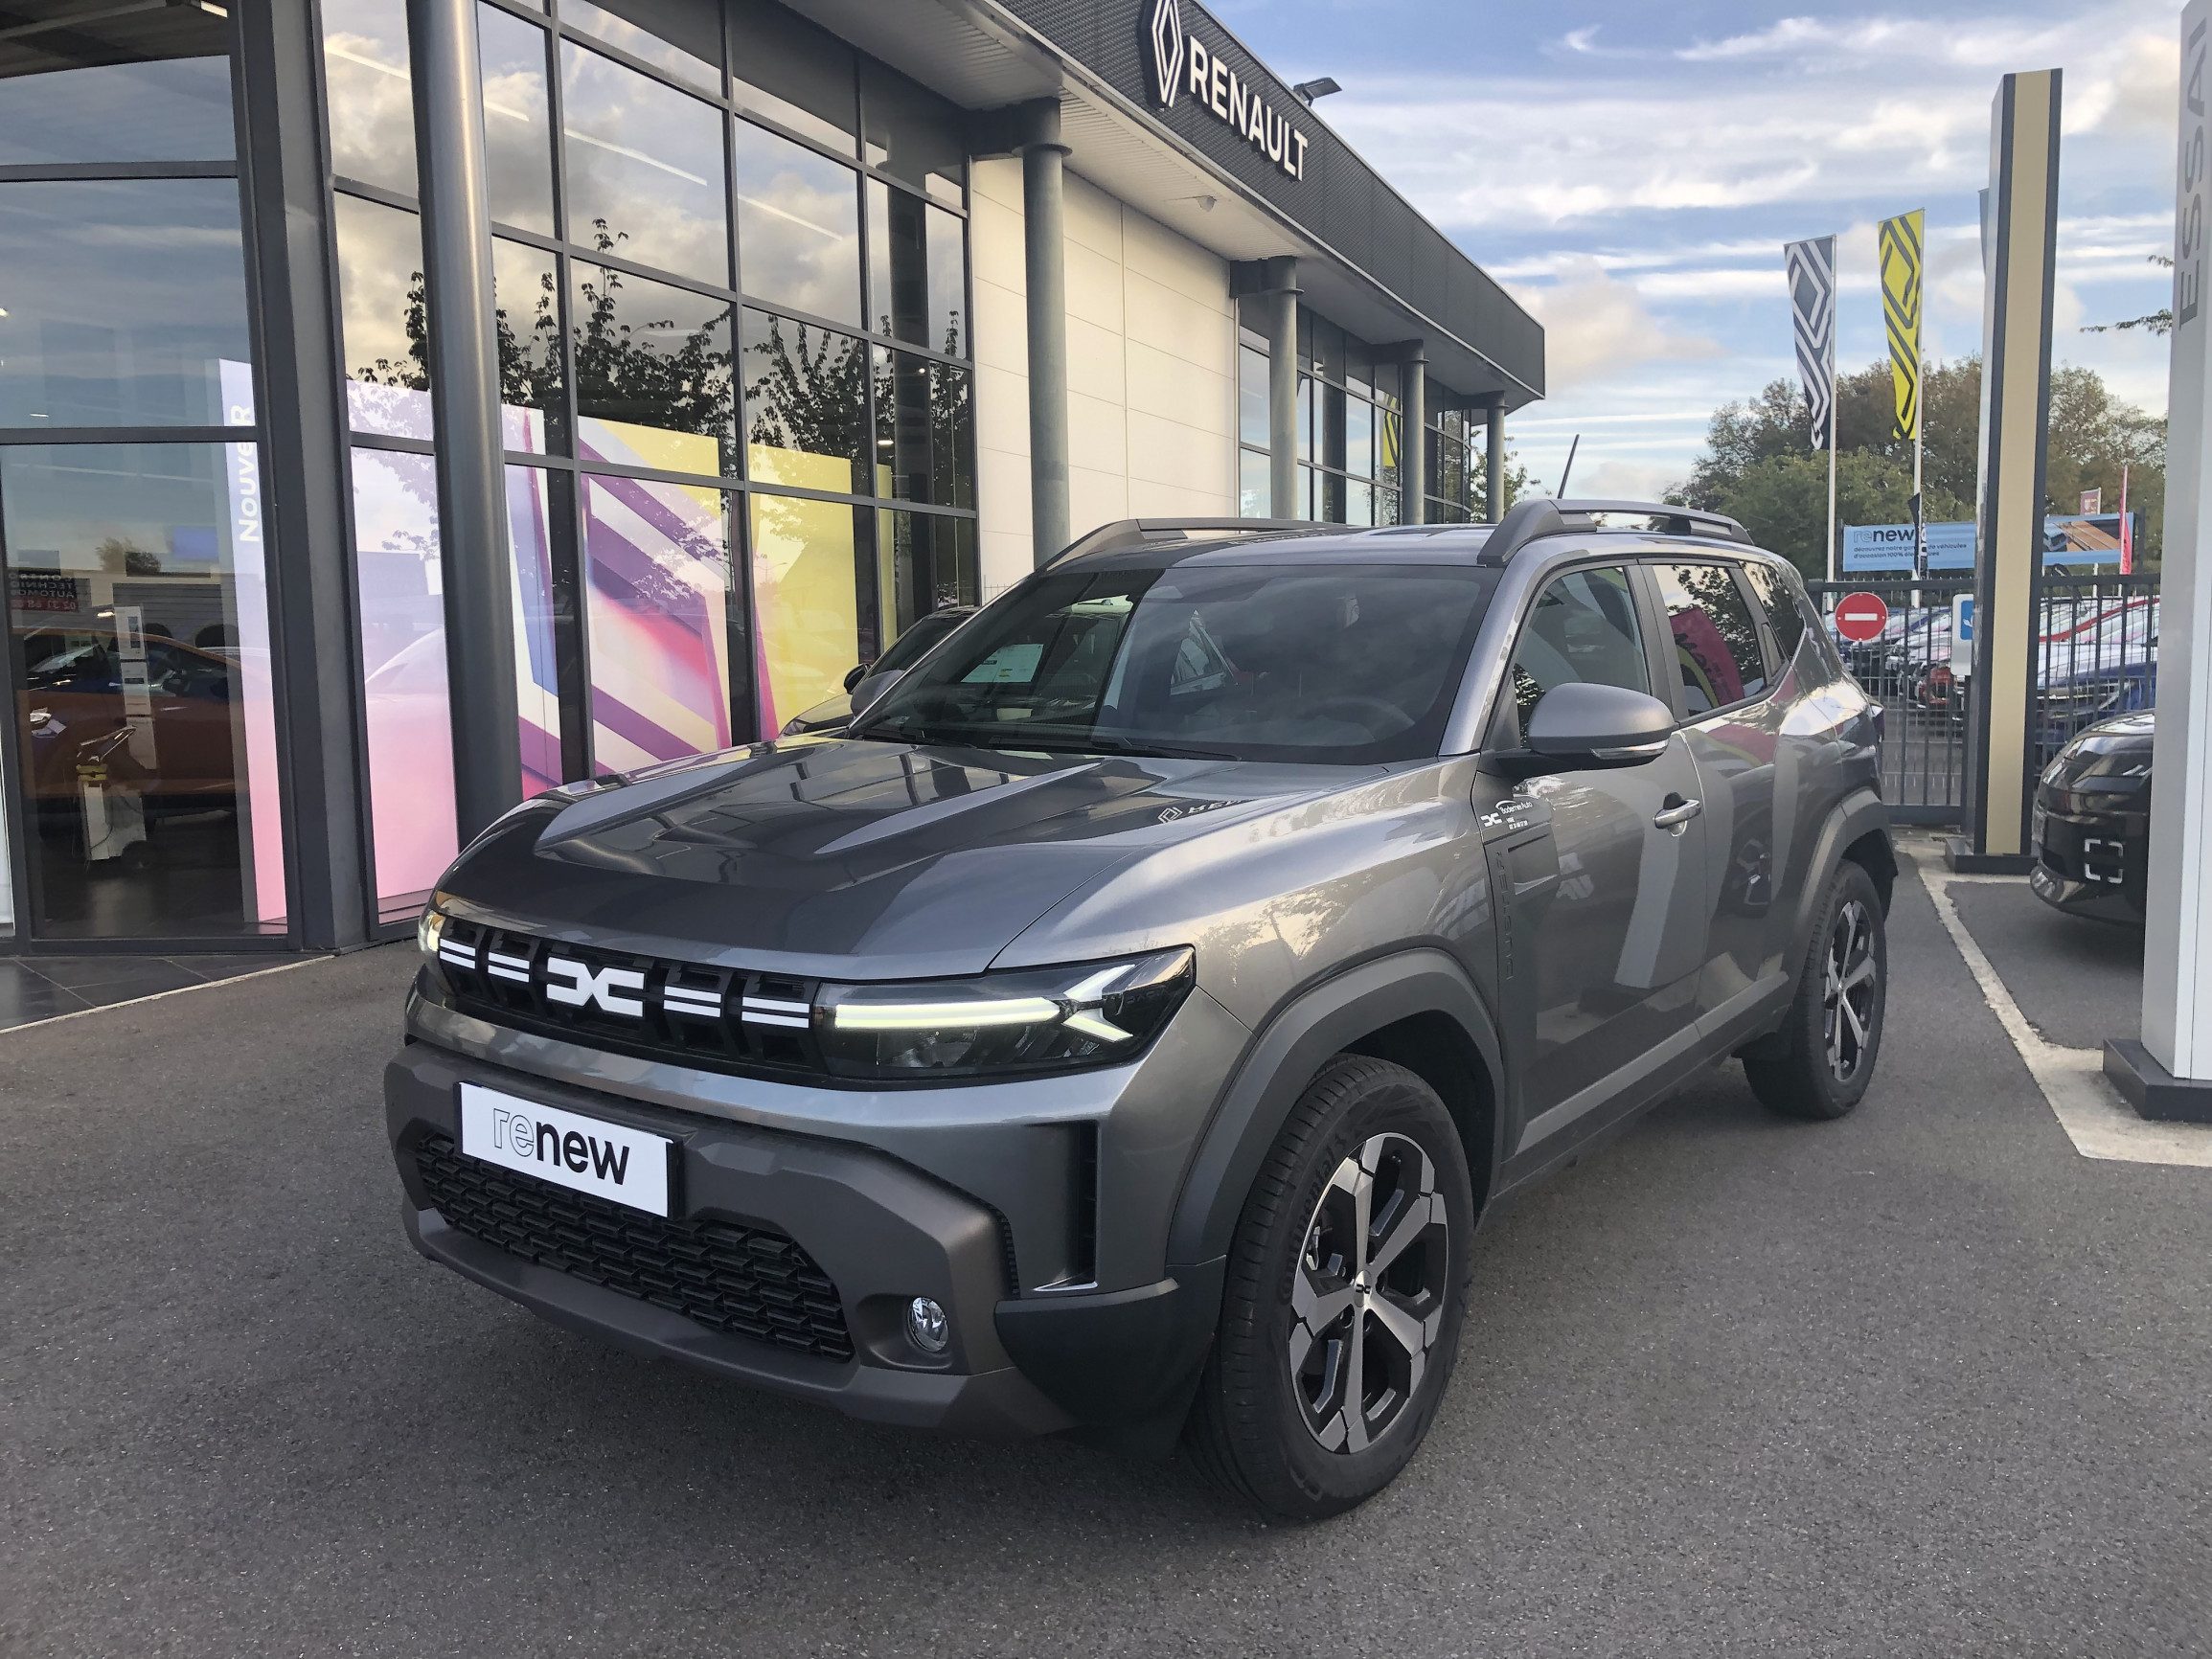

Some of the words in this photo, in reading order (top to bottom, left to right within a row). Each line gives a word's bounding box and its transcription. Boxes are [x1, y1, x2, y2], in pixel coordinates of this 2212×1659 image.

[1190, 34, 1308, 181] RENAULT
[2179, 16, 2207, 330] ESSAI
[1853, 529, 1915, 543] renew
[1495, 851, 1514, 980] DUSTER
[493, 1107, 630, 1186] renew
